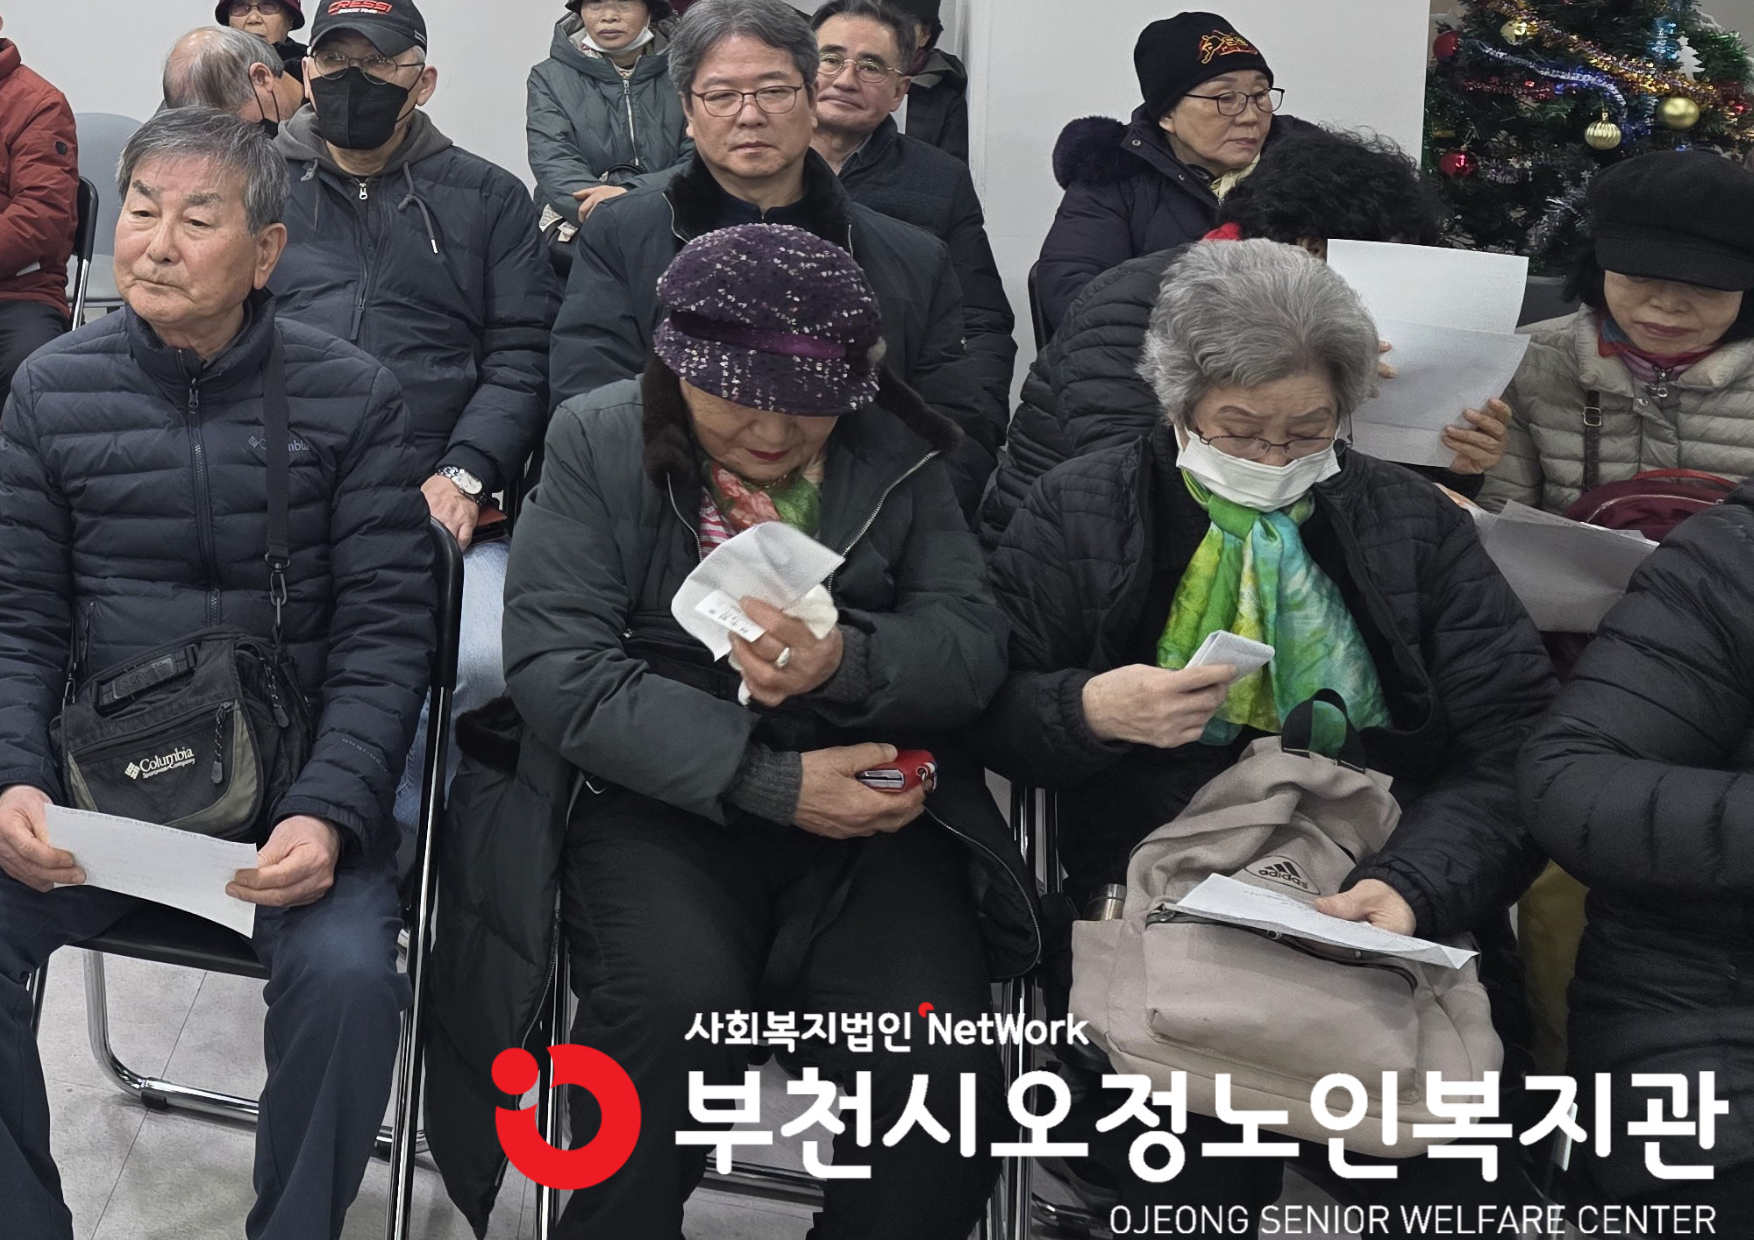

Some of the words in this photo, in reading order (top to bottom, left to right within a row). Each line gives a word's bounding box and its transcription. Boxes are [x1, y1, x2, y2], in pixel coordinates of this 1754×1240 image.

[327, 0, 393, 14] CRESSI
[140, 746, 194, 772] Columbia
[1258, 869, 1308, 889] adidas
